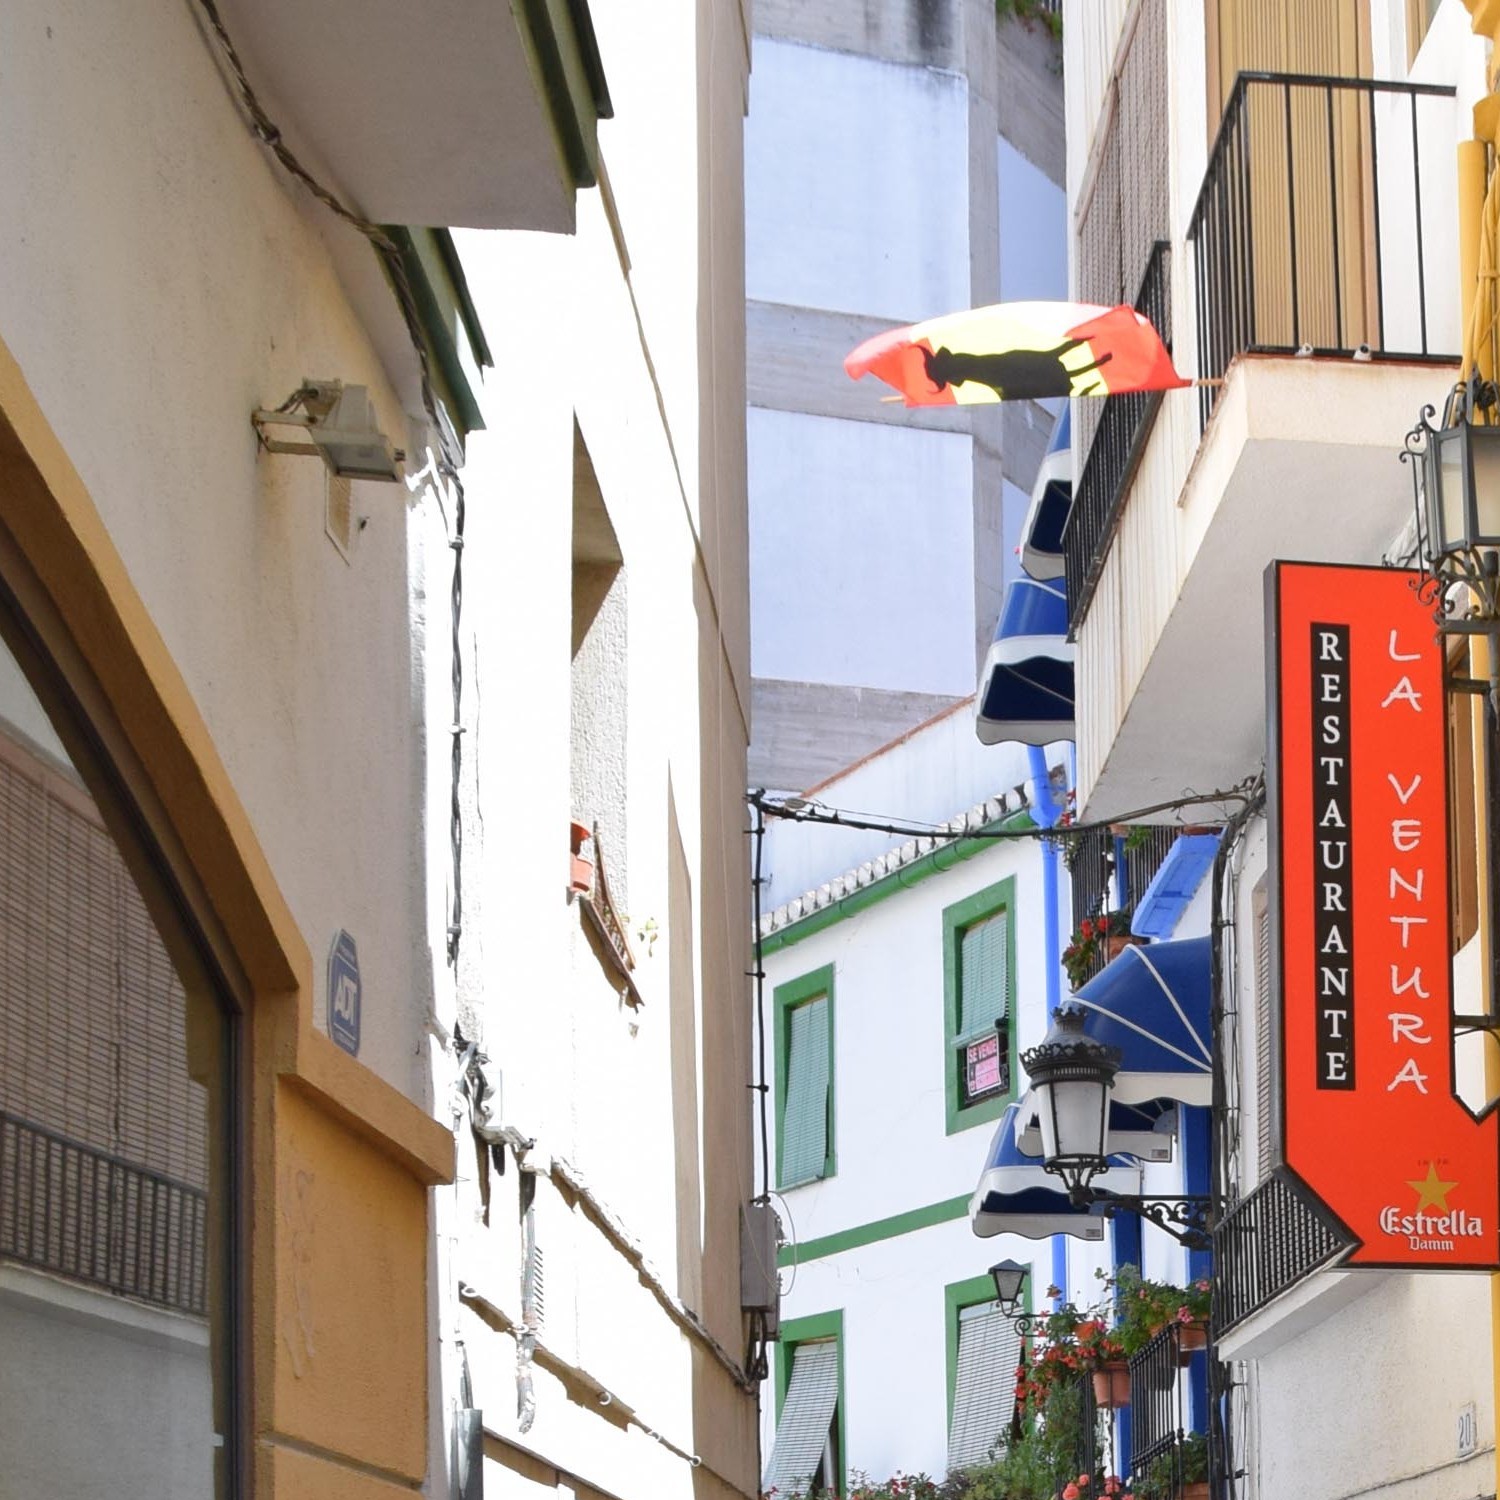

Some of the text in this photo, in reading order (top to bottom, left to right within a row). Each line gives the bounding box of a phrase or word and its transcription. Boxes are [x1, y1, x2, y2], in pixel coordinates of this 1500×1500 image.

[1319, 631, 1350, 1083] RESTAURANTE
[1381, 628, 1433, 1096] LA VENTURA
[1379, 1205, 1485, 1237] Estrella
[1407, 1235, 1455, 1251] Damm
